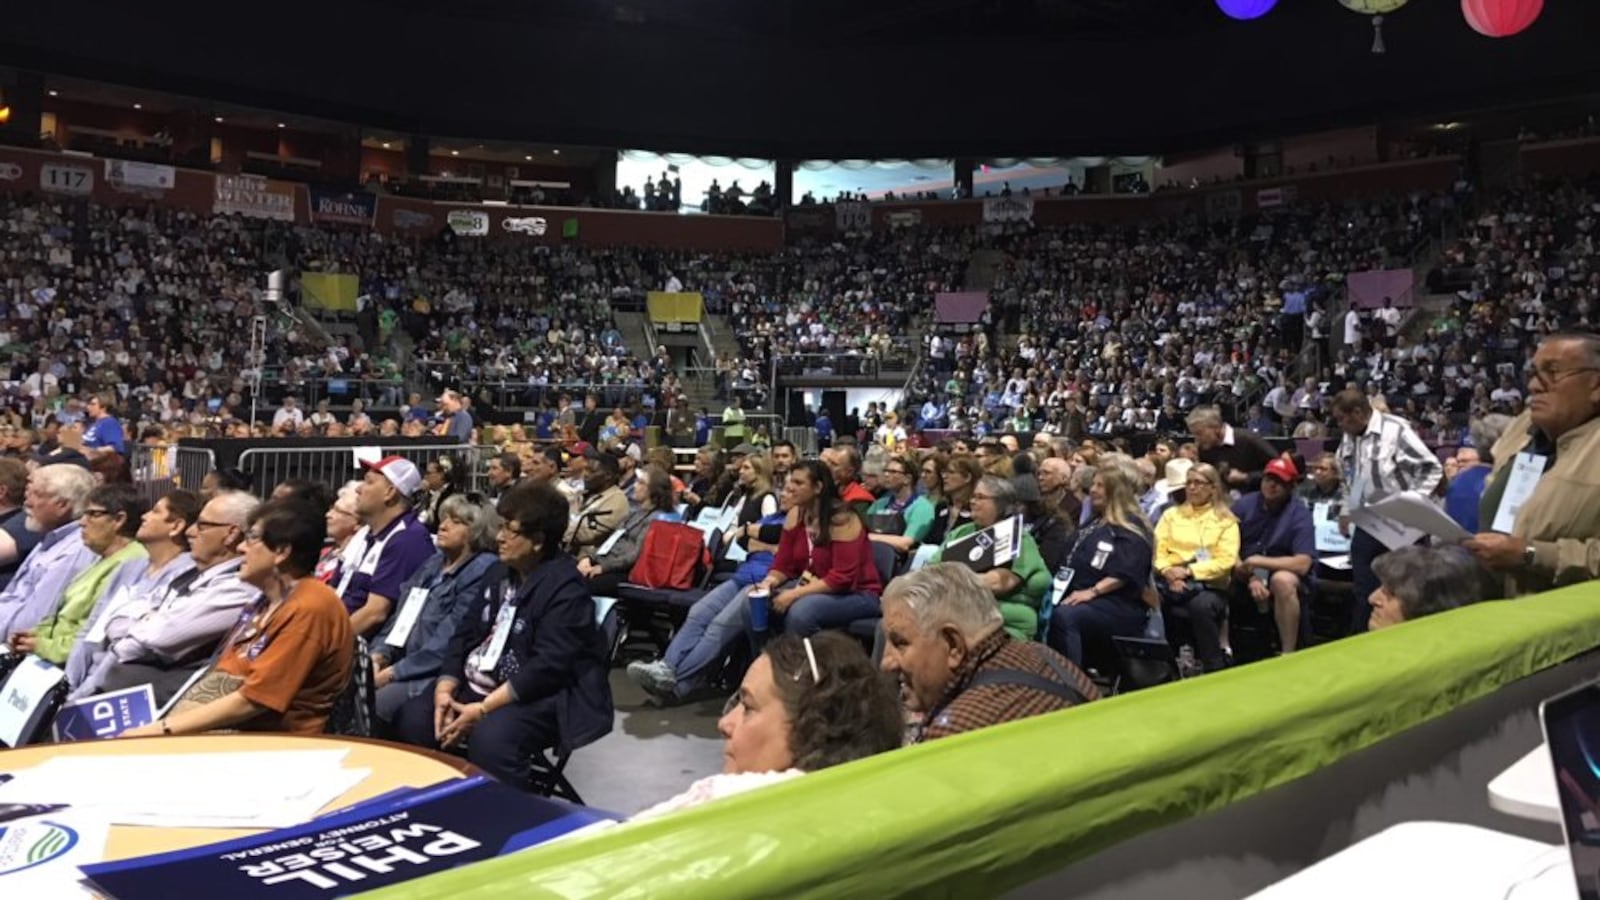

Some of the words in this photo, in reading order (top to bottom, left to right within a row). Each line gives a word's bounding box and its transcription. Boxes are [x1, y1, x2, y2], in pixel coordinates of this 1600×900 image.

[51, 169, 86, 187] 117
[217, 189, 291, 208] WINTER
[119, 698, 132, 726] STATE
[318, 811, 409, 841] ATTORNEY
[219, 837, 314, 862] GENERAL
[238, 823, 443, 878] WEISER
[315, 837, 347, 849] FOR
[262, 831, 482, 889] PHIL
